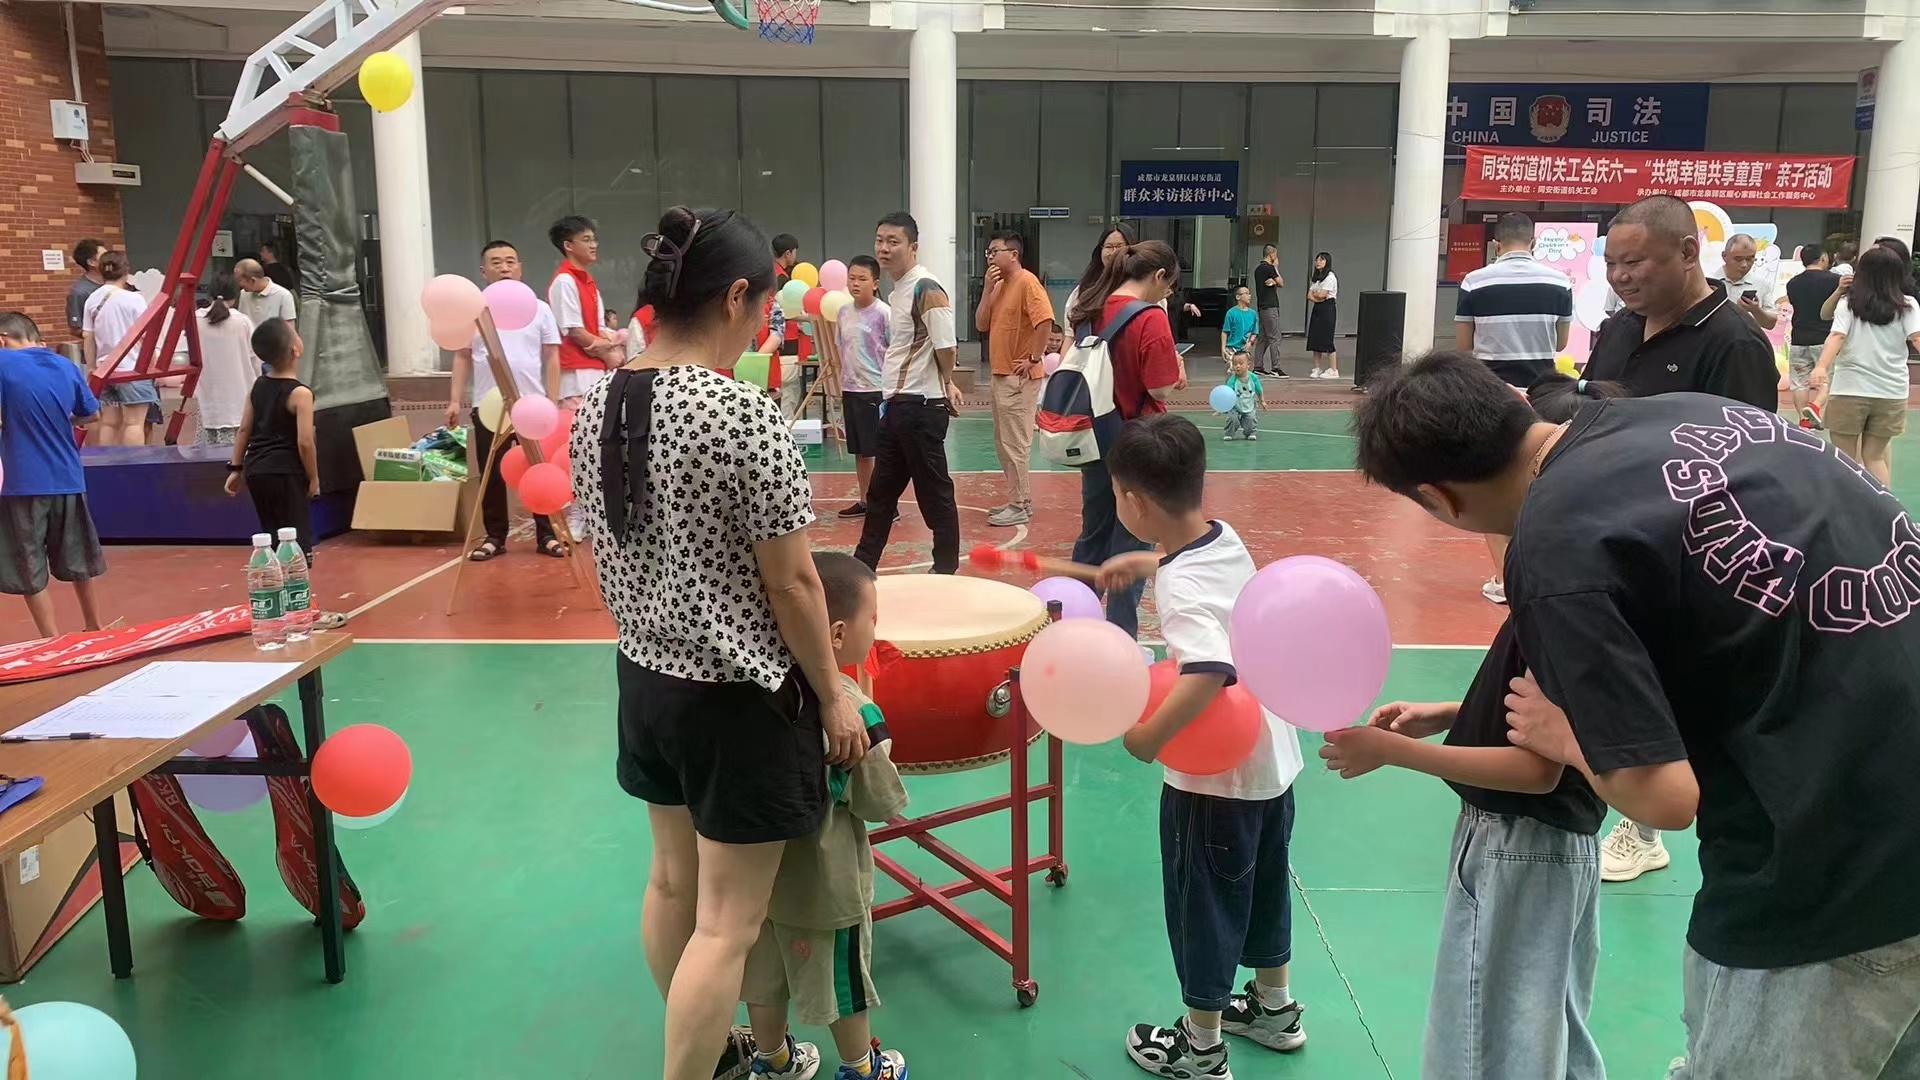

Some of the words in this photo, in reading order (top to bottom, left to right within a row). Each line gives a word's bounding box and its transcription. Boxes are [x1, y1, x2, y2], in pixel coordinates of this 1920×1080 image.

[1447, 96, 1517, 126] 中国
[1587, 96, 1661, 126] 司法
[1452, 131, 1499, 143] CHINA
[1591, 131, 1649, 143] JUSTICE
[1137, 173, 1222, 182] 成都市龙泉驿区同安街道
[1481, 154, 1637, 183] 同安街道机关工会庆六一
[1776, 161, 1833, 188] 亲子活动
[1123, 187, 1235, 202] 群众来访接待中心
[1662, 459, 1805, 617] KIDS
